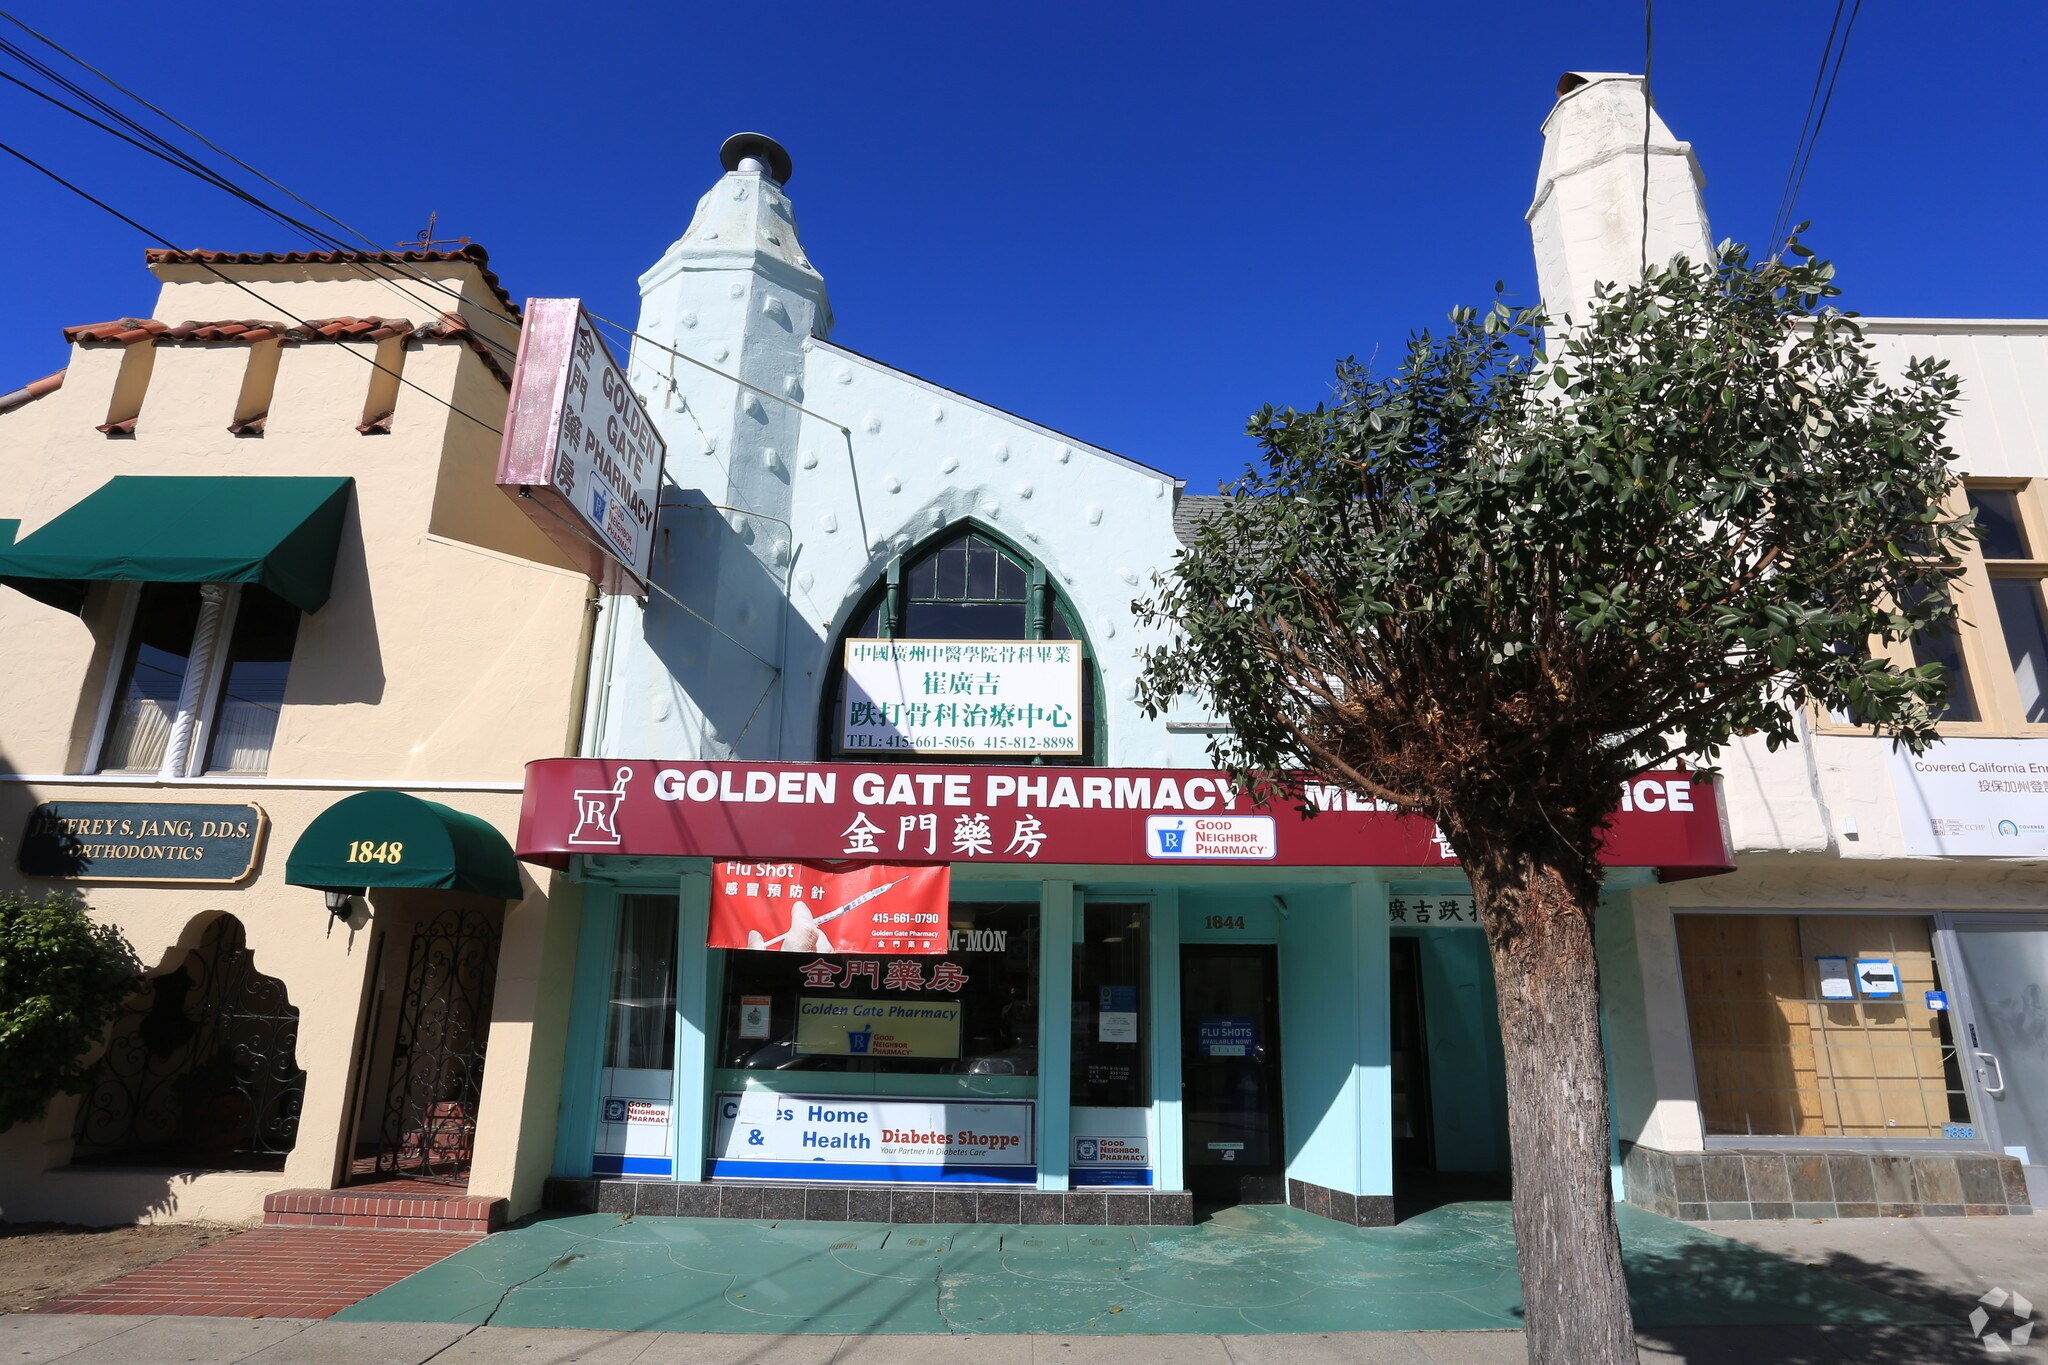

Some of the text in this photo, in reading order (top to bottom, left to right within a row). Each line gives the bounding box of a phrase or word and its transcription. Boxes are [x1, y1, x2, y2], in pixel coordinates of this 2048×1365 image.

[602, 366, 656, 465] GOLDEN
[606, 414, 643, 484] GATE
[584, 427, 653, 532] PHARMACY
[922, 671, 1001, 696] 崔廣吉
[850, 701, 1072, 729] 跌打骨科治療中心
[886, 735, 975, 748] 415-661-5056
[984, 736, 1074, 749] 415-812-8898
[1914, 761, 1966, 773] Covered
[1969, 761, 2026, 773] California
[653, 769, 837, 804] GOLDEN
[852, 772, 972, 807] GATE
[986, 776, 1240, 811] PHARMACY
[119, 820, 134, 836] S.
[136, 819, 194, 840] JANG,
[200, 821, 251, 839] D.D.S.
[1195, 819, 1232, 830] GOOD
[839, 811, 1048, 859] 金門藥房
[1195, 831, 1258, 842] NEIGHBOR
[69, 844, 204, 861] ORTHODONTICS
[346, 840, 402, 865] 1848
[1195, 843, 1265, 855] PHARMACY
[726, 861, 794, 878] Flu Shot
[725, 881, 825, 900] 感冒預防針
[872, 912, 939, 924] 415-661-0790
[1204, 915, 1246, 930] 1844
[871, 929, 894, 937] Golden
[909, 930, 939, 938] Pharmacy
[800, 958, 970, 993] 金門藥房
[801, 1003, 958, 1021] Golden Gate Pharmacy
[873, 1033, 895, 1041] GOOD
[1201, 1028, 1252, 1037] FLU SHOTS
[872, 1040, 908, 1048] NEIGHBOR
[872, 1048, 911, 1056] PHARMACY
[628, 1100, 652, 1108] GOOD
[626, 1115, 670, 1123] PHARMACY
[627, 1108, 666, 1116] NEIGHBOR
[808, 1105, 868, 1123] Home
[748, 1128, 765, 1146] &
[881, 1129, 1019, 1150] Diabetes Shoppe
[1945, 1126, 1974, 1138] 1836
[802, 1131, 871, 1149] Health
[898, 1147, 925, 1155] Partner
[936, 1148, 968, 1156] Diabetes
[1100, 1146, 1140, 1154] NEIGHBOR
[1100, 1153, 1145, 1161] PHARMACY
